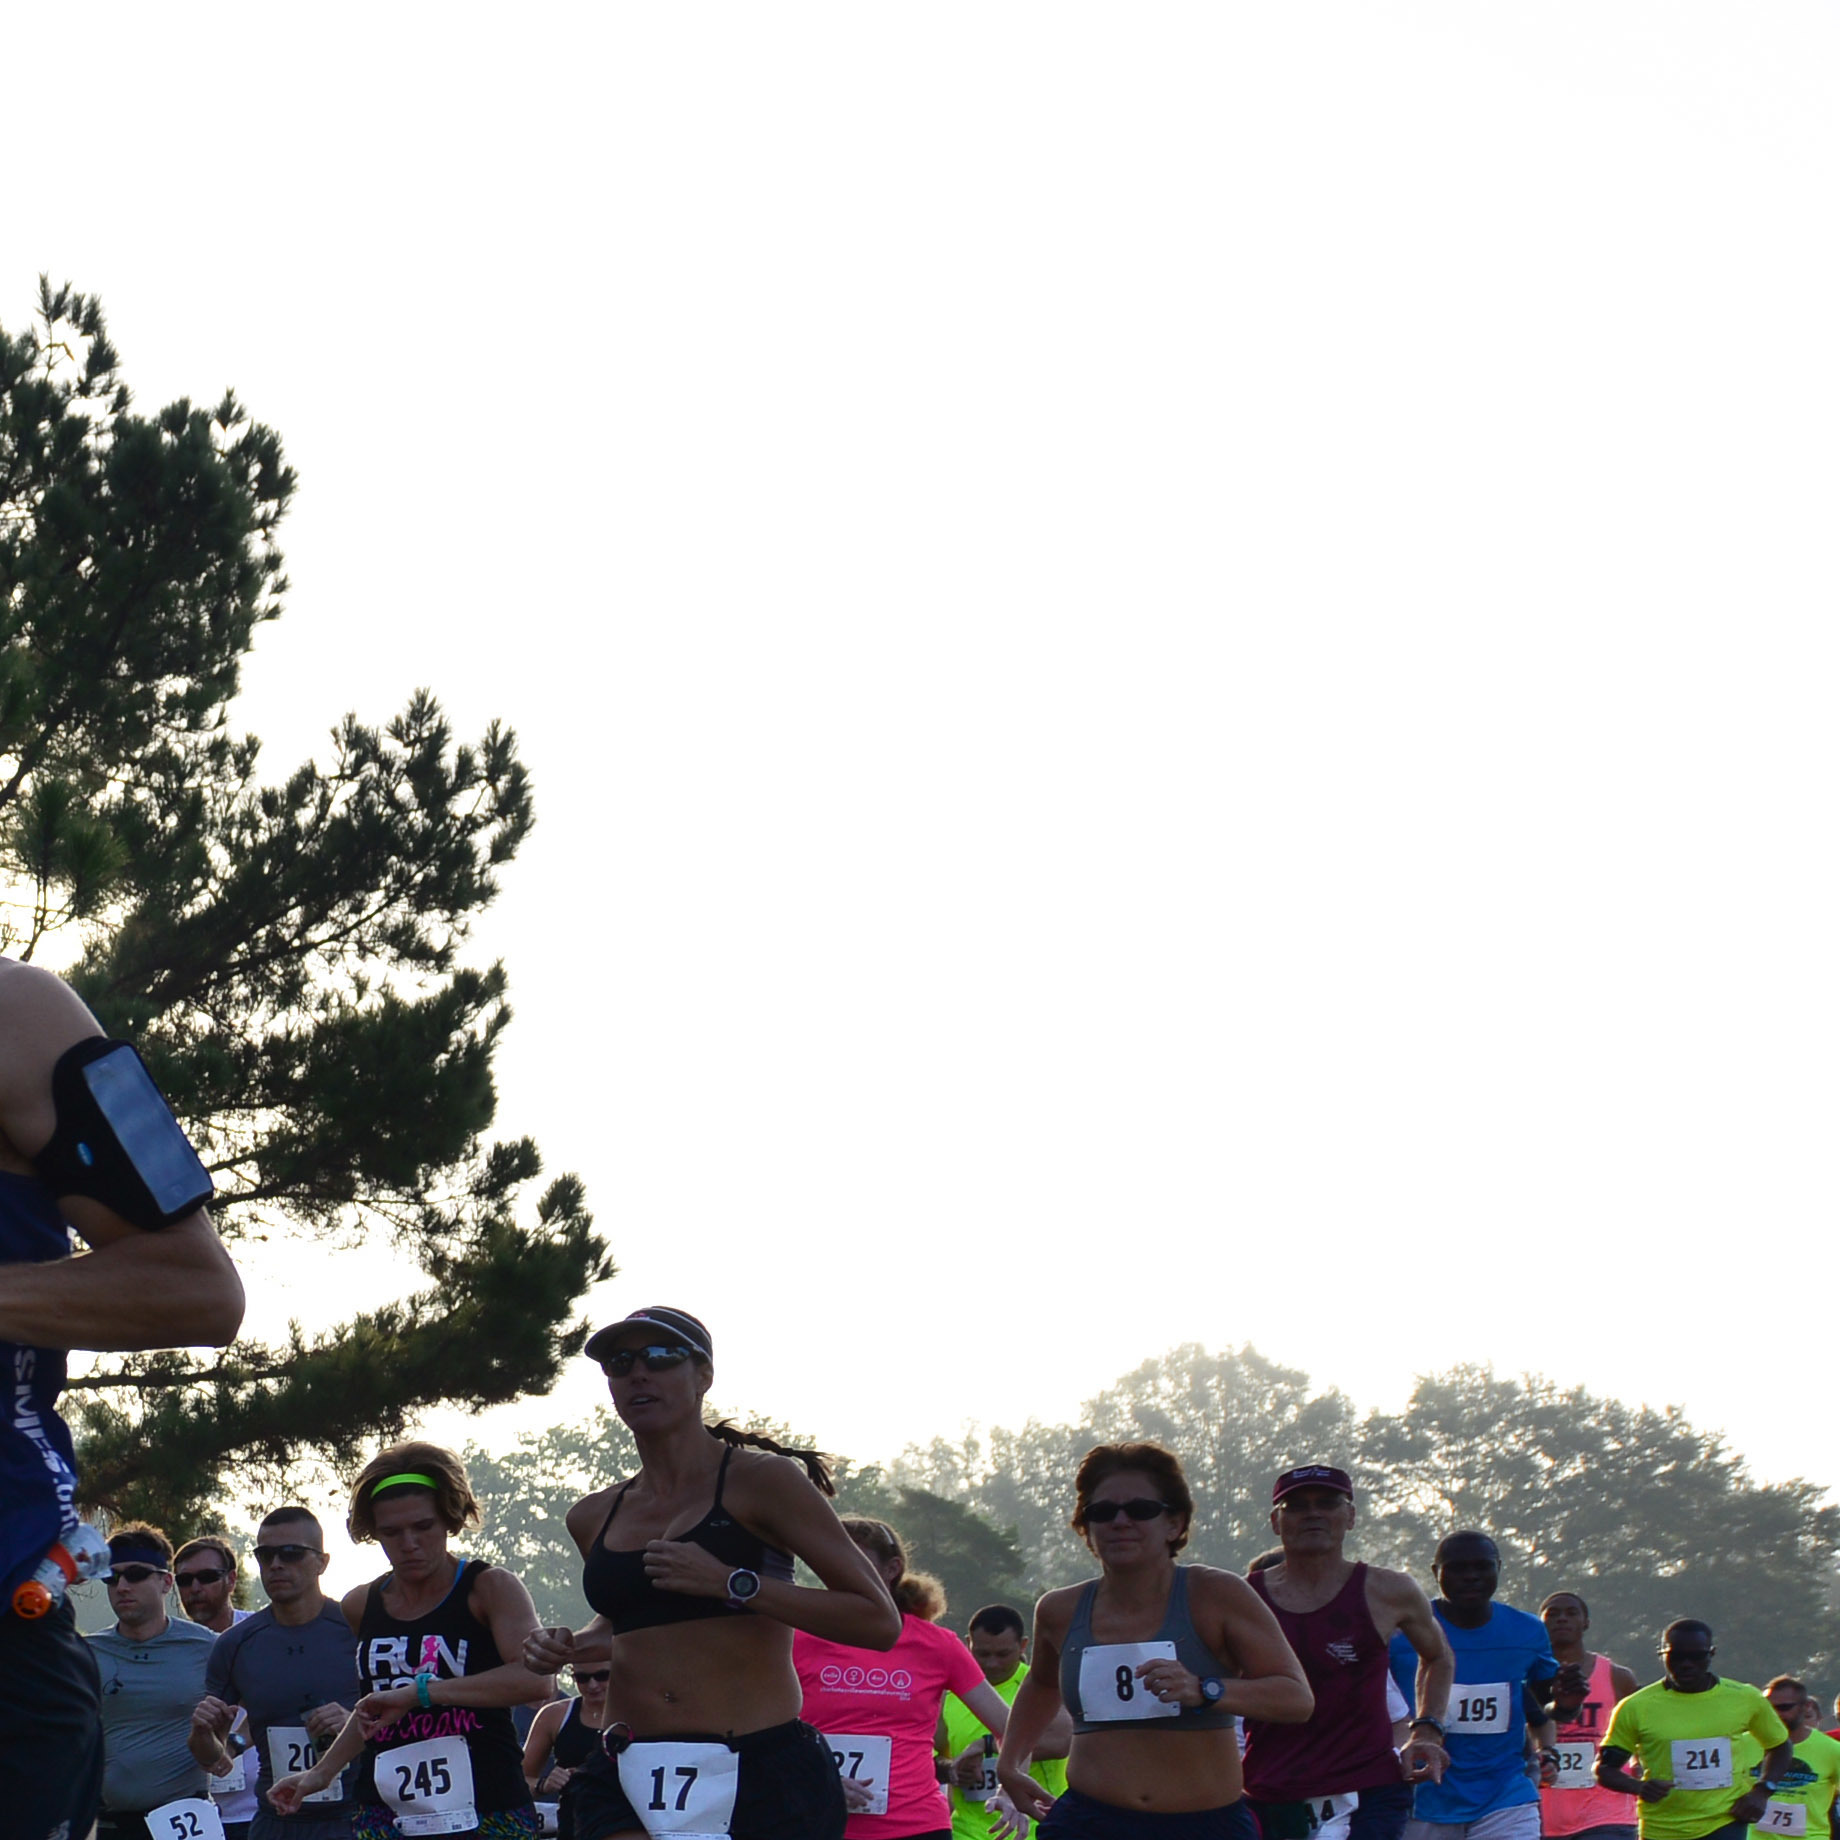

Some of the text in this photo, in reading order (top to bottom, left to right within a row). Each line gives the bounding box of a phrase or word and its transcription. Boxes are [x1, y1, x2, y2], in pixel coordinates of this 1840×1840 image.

[368, 1634, 469, 1677] RUN
[1116, 1665, 1134, 1701] 8
[1458, 1697, 1497, 1722] 195
[288, 1744, 316, 1772] 20
[1559, 1753, 1583, 1770] 32
[1686, 1748, 1721, 1770] 214
[395, 1757, 451, 1801] 245
[648, 1766, 698, 1811] 17
[169, 1812, 203, 1840] 52
[1772, 1811, 1793, 1827] 75
